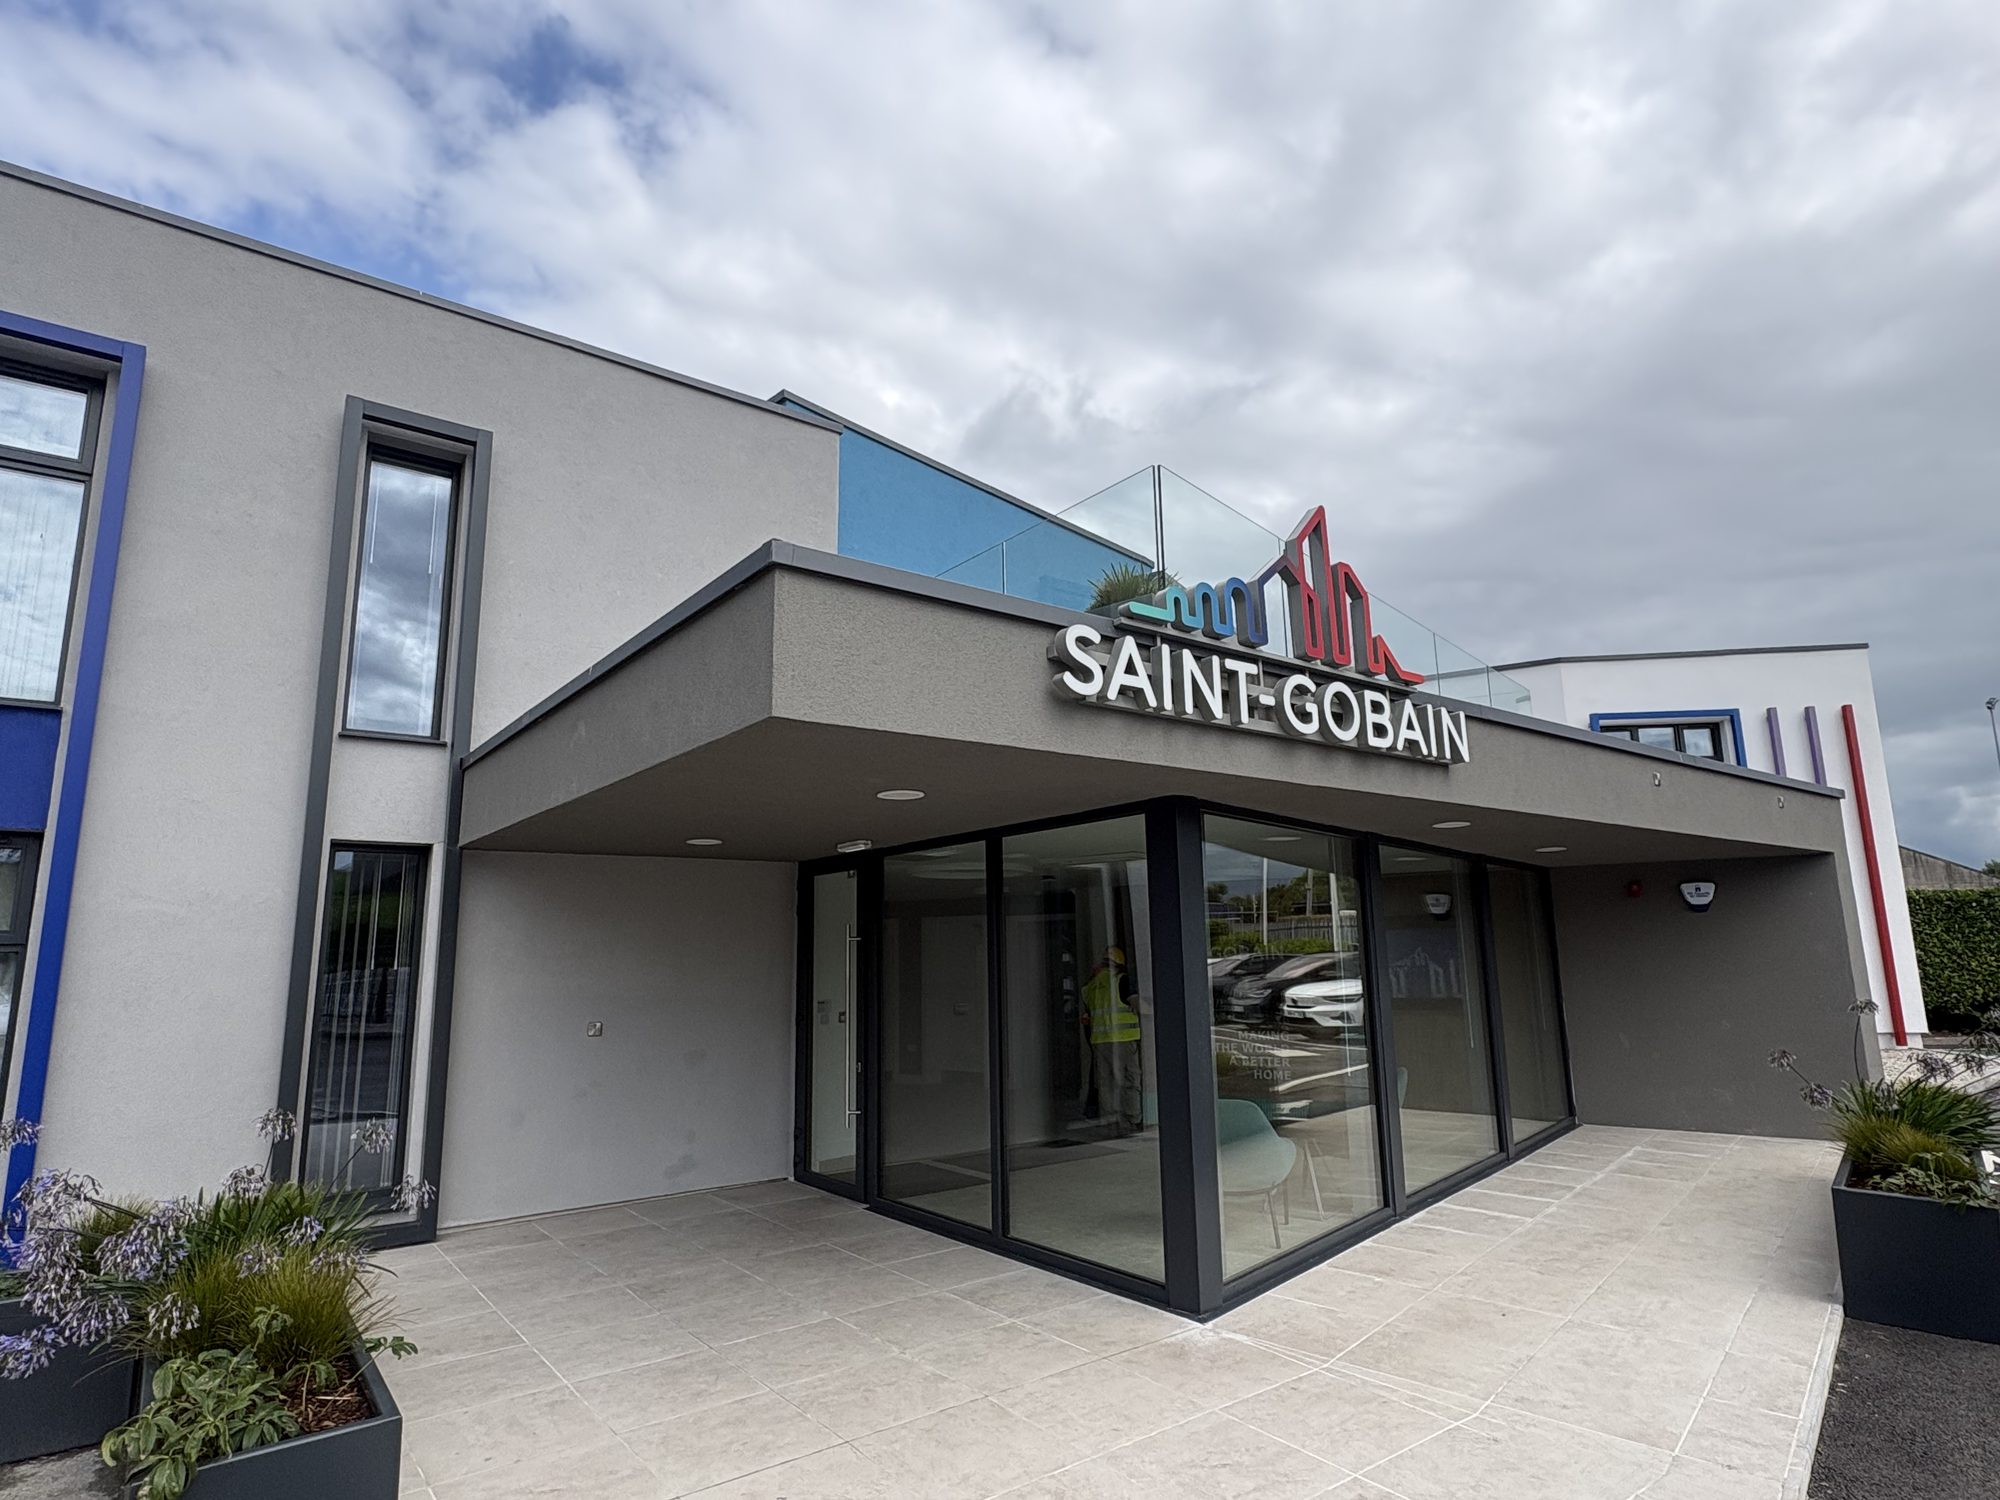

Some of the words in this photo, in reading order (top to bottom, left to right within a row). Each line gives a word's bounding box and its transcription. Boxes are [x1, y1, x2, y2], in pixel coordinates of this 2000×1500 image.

[1060, 623, 1471, 764] SAINT-GOBAIN
[1238, 1030, 1289, 1041] MAKING
[1216, 1042, 1238, 1053] THE
[1229, 1055, 1238, 1066] A
[1242, 1056, 1291, 1067] BETTER
[1254, 1069, 1292, 1081] HOME
